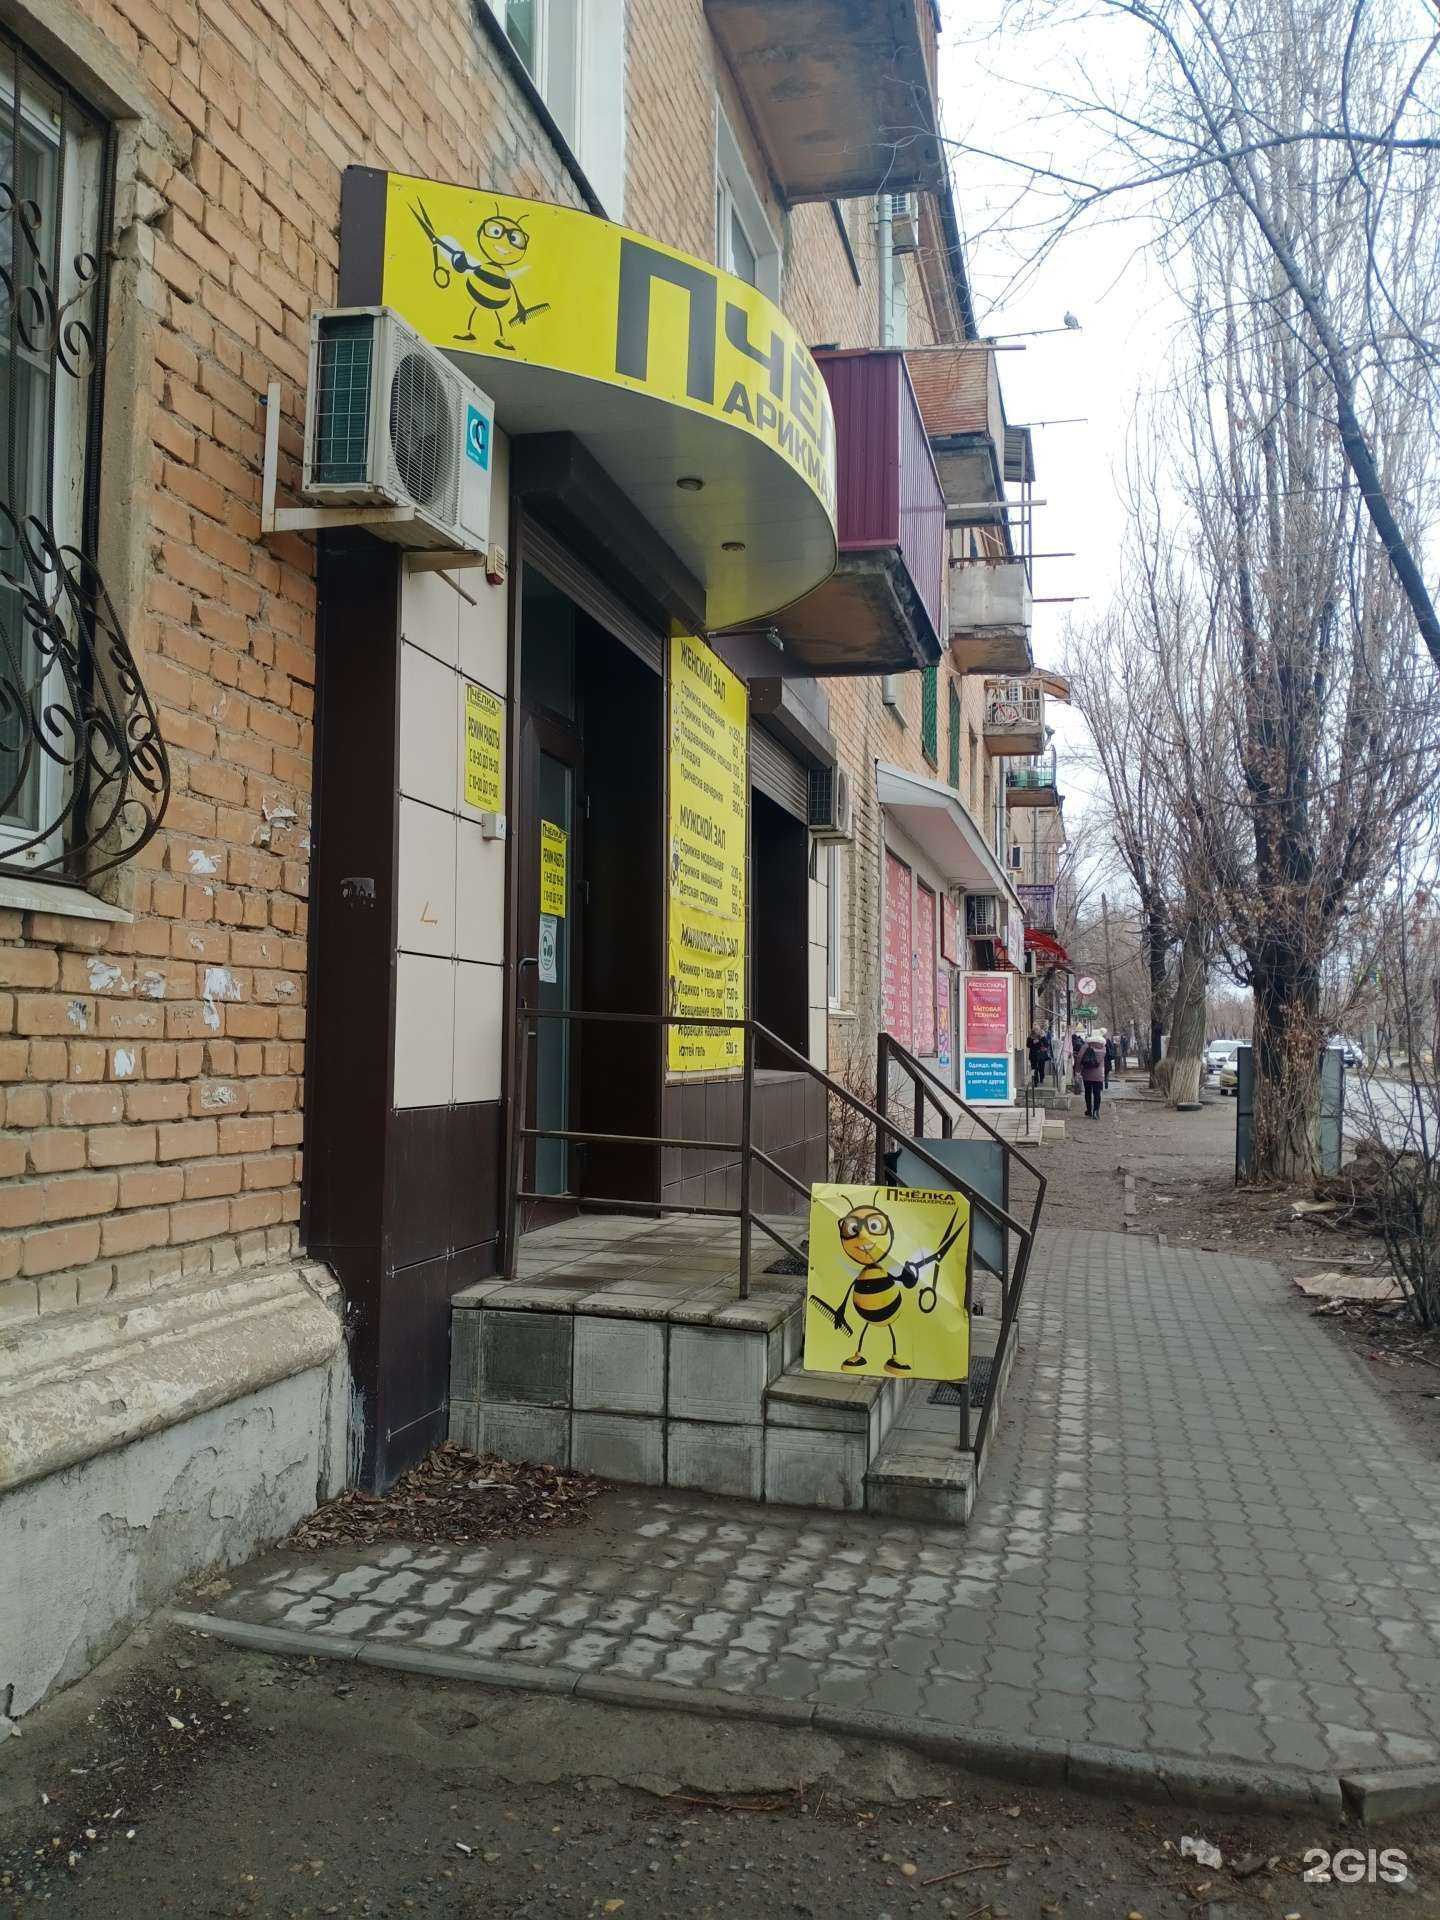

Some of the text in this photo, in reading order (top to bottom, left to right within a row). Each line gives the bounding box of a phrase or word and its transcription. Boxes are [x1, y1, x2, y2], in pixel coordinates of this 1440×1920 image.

[681, 640, 726, 703] ЖЕНСКИЙ ЗАЛ
[681, 741, 700, 768] Укладка
[680, 804, 726, 850] МУЖСКОЙ ЗАЛ
[680, 838, 700, 860] Стрижка
[680, 859, 700, 880] Стрижка
[680, 880, 699, 899] Детская
